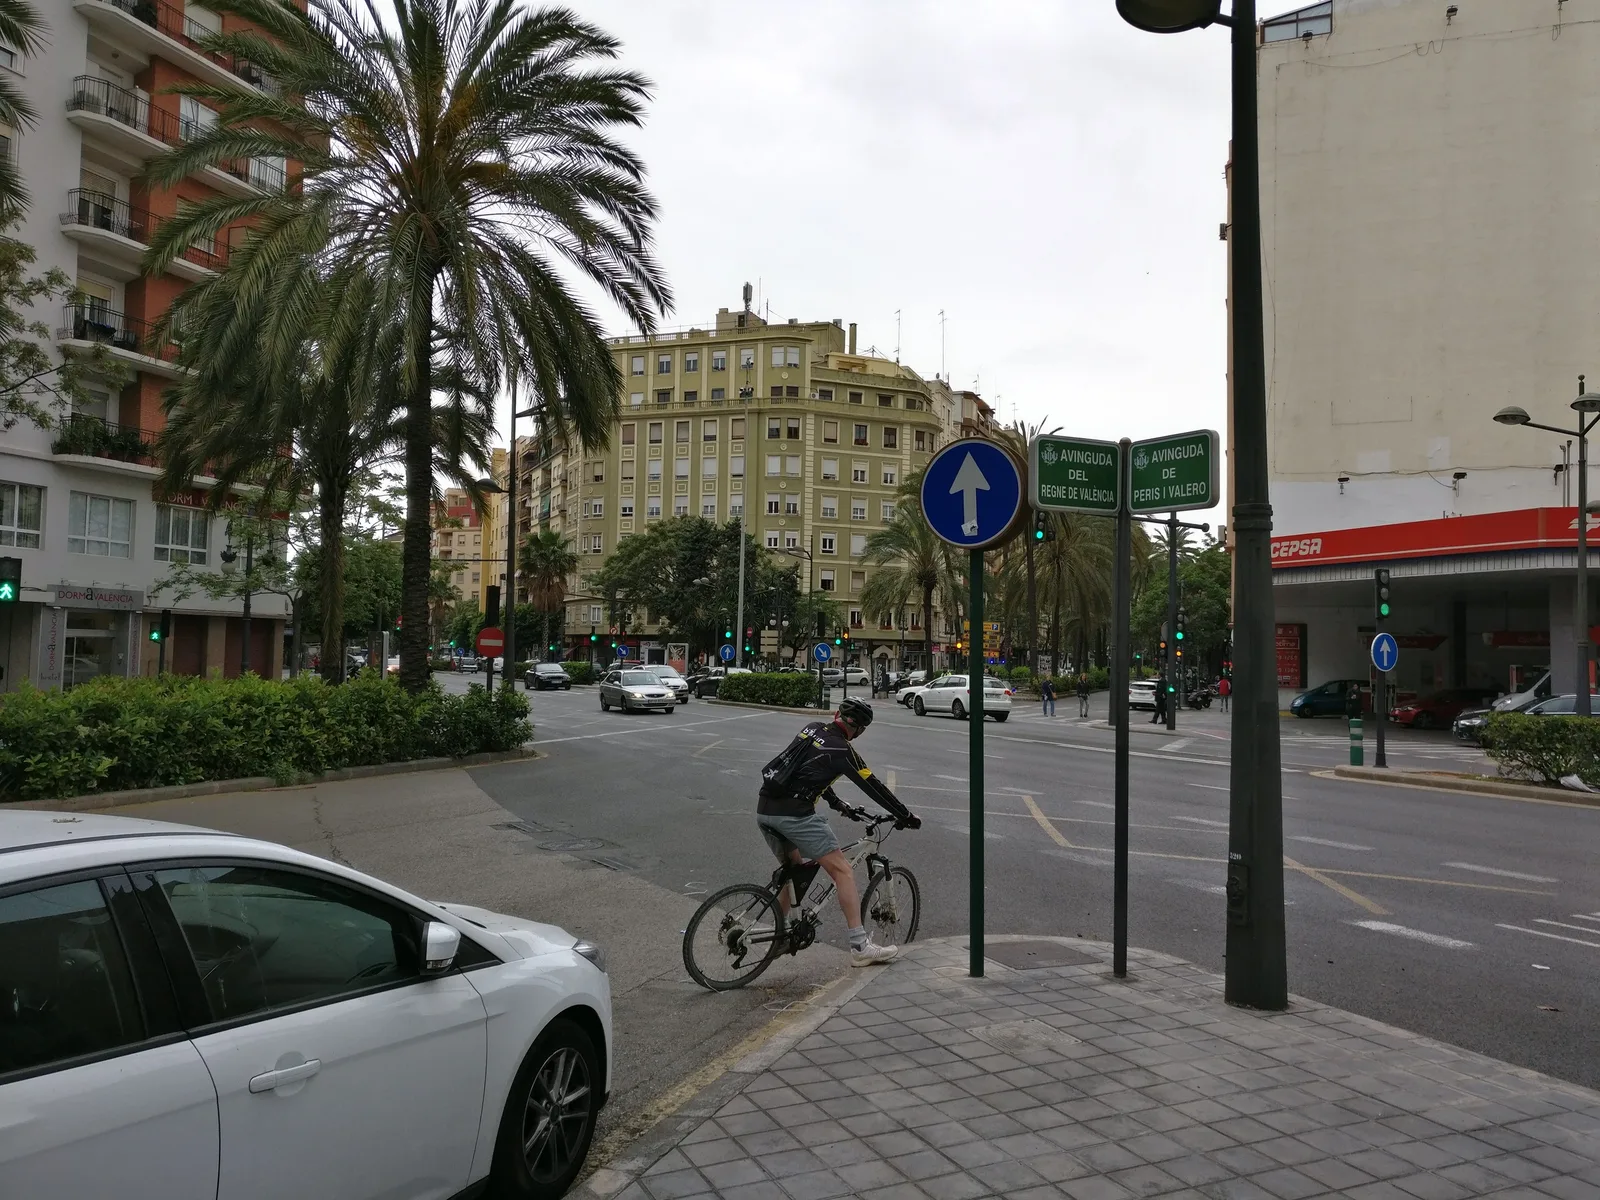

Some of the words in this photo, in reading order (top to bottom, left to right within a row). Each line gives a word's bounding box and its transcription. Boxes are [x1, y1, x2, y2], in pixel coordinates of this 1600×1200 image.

[1060, 449, 1113, 467] AVINGUDA
[1151, 443, 1204, 464] AVINGUDA
[1068, 469, 1089, 482] DEL
[1162, 467, 1176, 480] DE
[1041, 484, 1067, 499] REGNE
[1068, 486, 1078, 500] DE
[1079, 485, 1115, 503] VALÈNCIA
[1133, 487, 1160, 502] PERIS
[1162, 486, 1167, 499] I
[1168, 481, 1206, 498] VALERO
[1270, 537, 1322, 559] CEPSA
